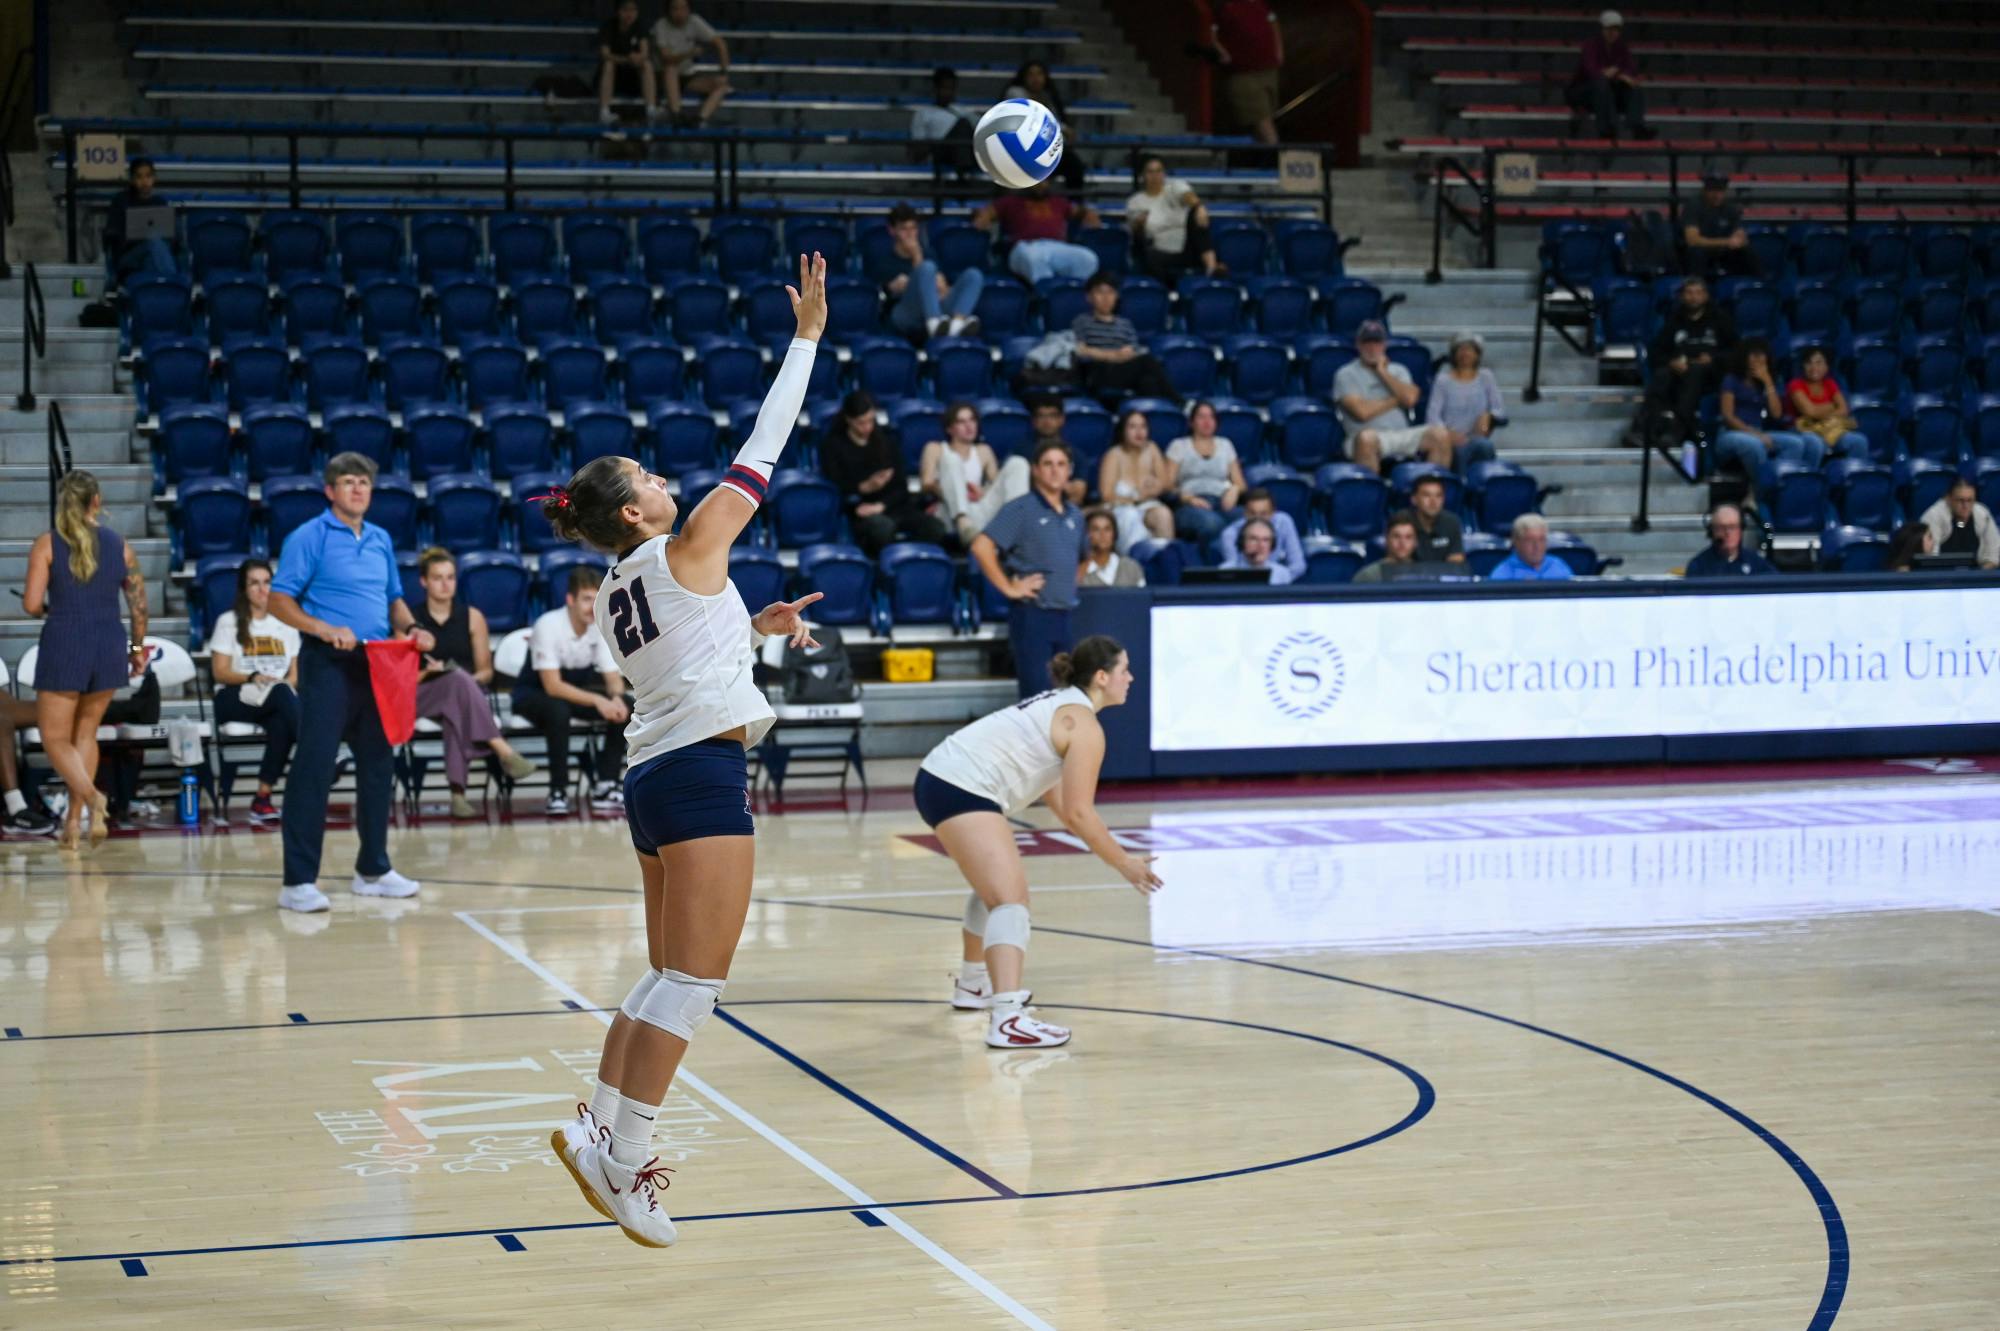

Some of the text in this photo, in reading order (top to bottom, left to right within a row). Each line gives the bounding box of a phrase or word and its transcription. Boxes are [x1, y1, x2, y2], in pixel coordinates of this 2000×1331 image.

[84, 146, 118, 165] 103
[608, 575, 661, 659] 21
[1426, 638, 2000, 694] Sheraton Philadelphia Univ
